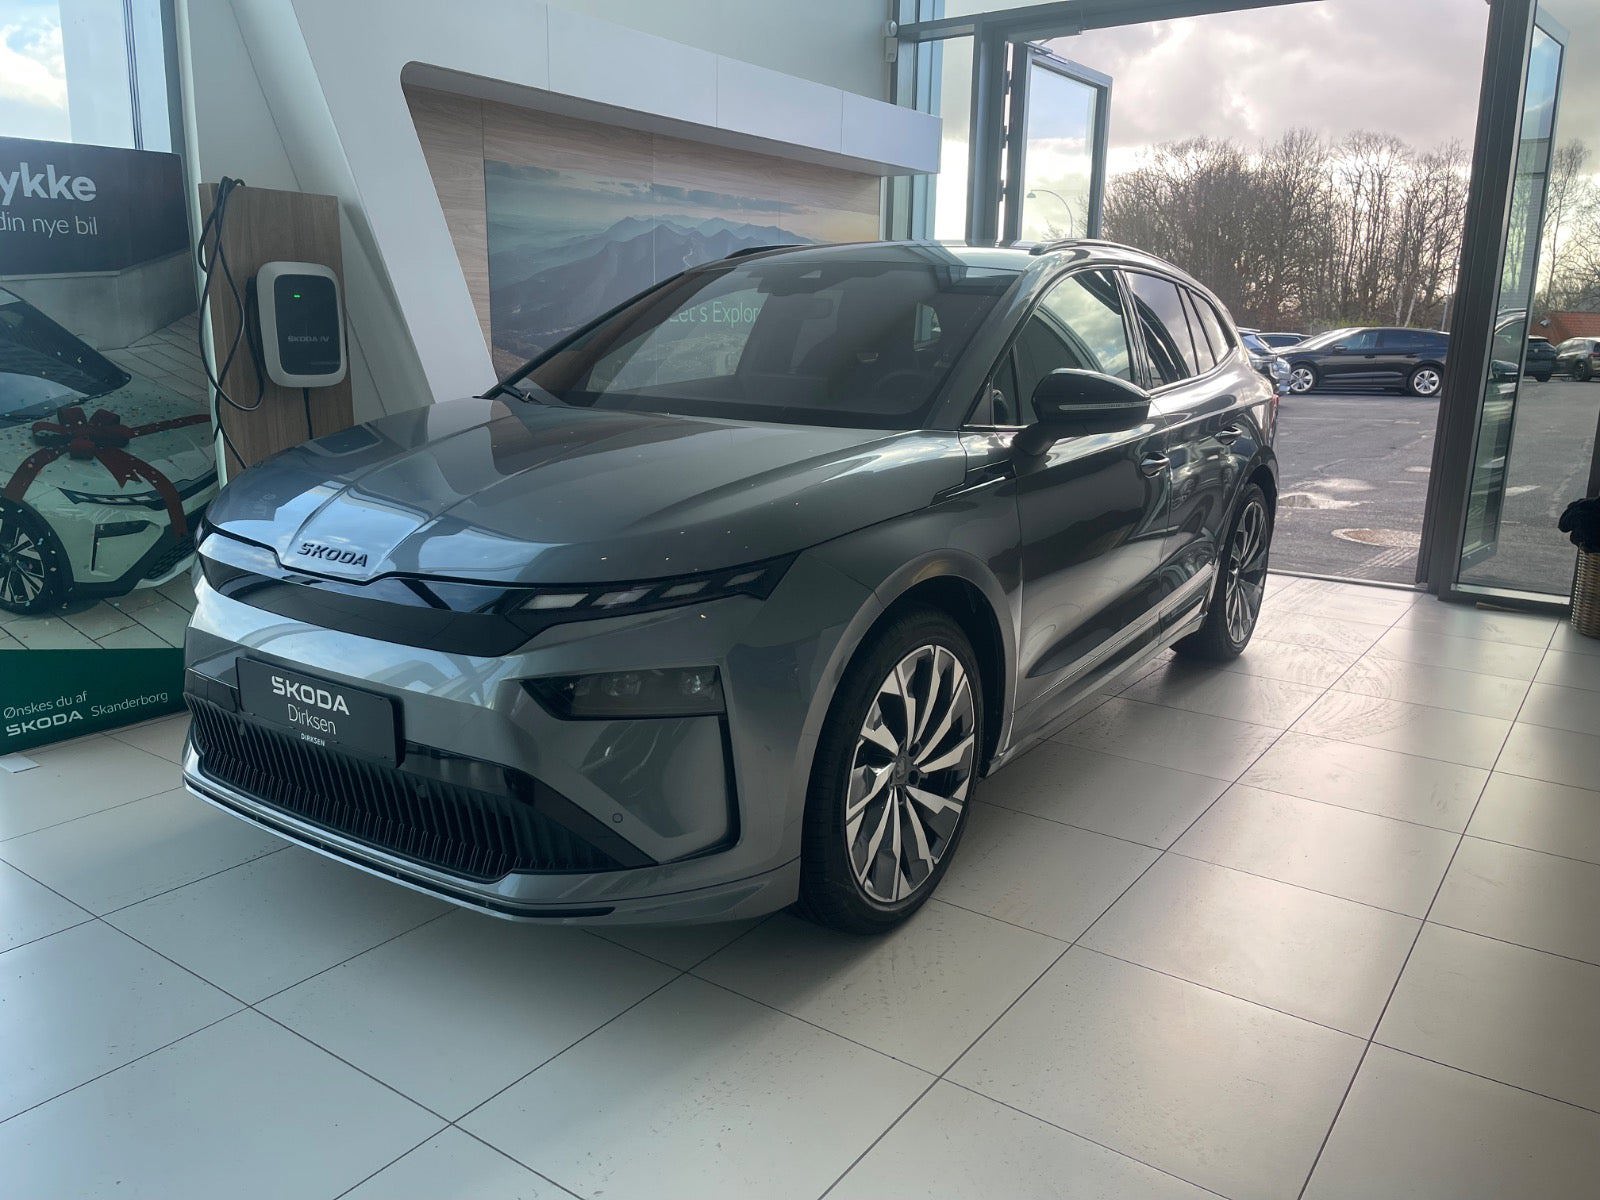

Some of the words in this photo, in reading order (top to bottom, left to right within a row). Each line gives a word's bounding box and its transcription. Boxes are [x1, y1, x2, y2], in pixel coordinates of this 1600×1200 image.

[0, 162, 97, 206] ykke
[32, 218, 69, 239] nye
[75, 215, 98, 236] bil
[297, 542, 368, 568] SKODA
[3, 701, 54, 719] Ønskes
[56, 695, 73, 707] du
[75, 690, 88, 704] af
[271, 675, 350, 716] SKODA
[5, 710, 84, 737] SKODA
[90, 692, 169, 717] Skanderborg
[287, 703, 337, 735] Dirksen
